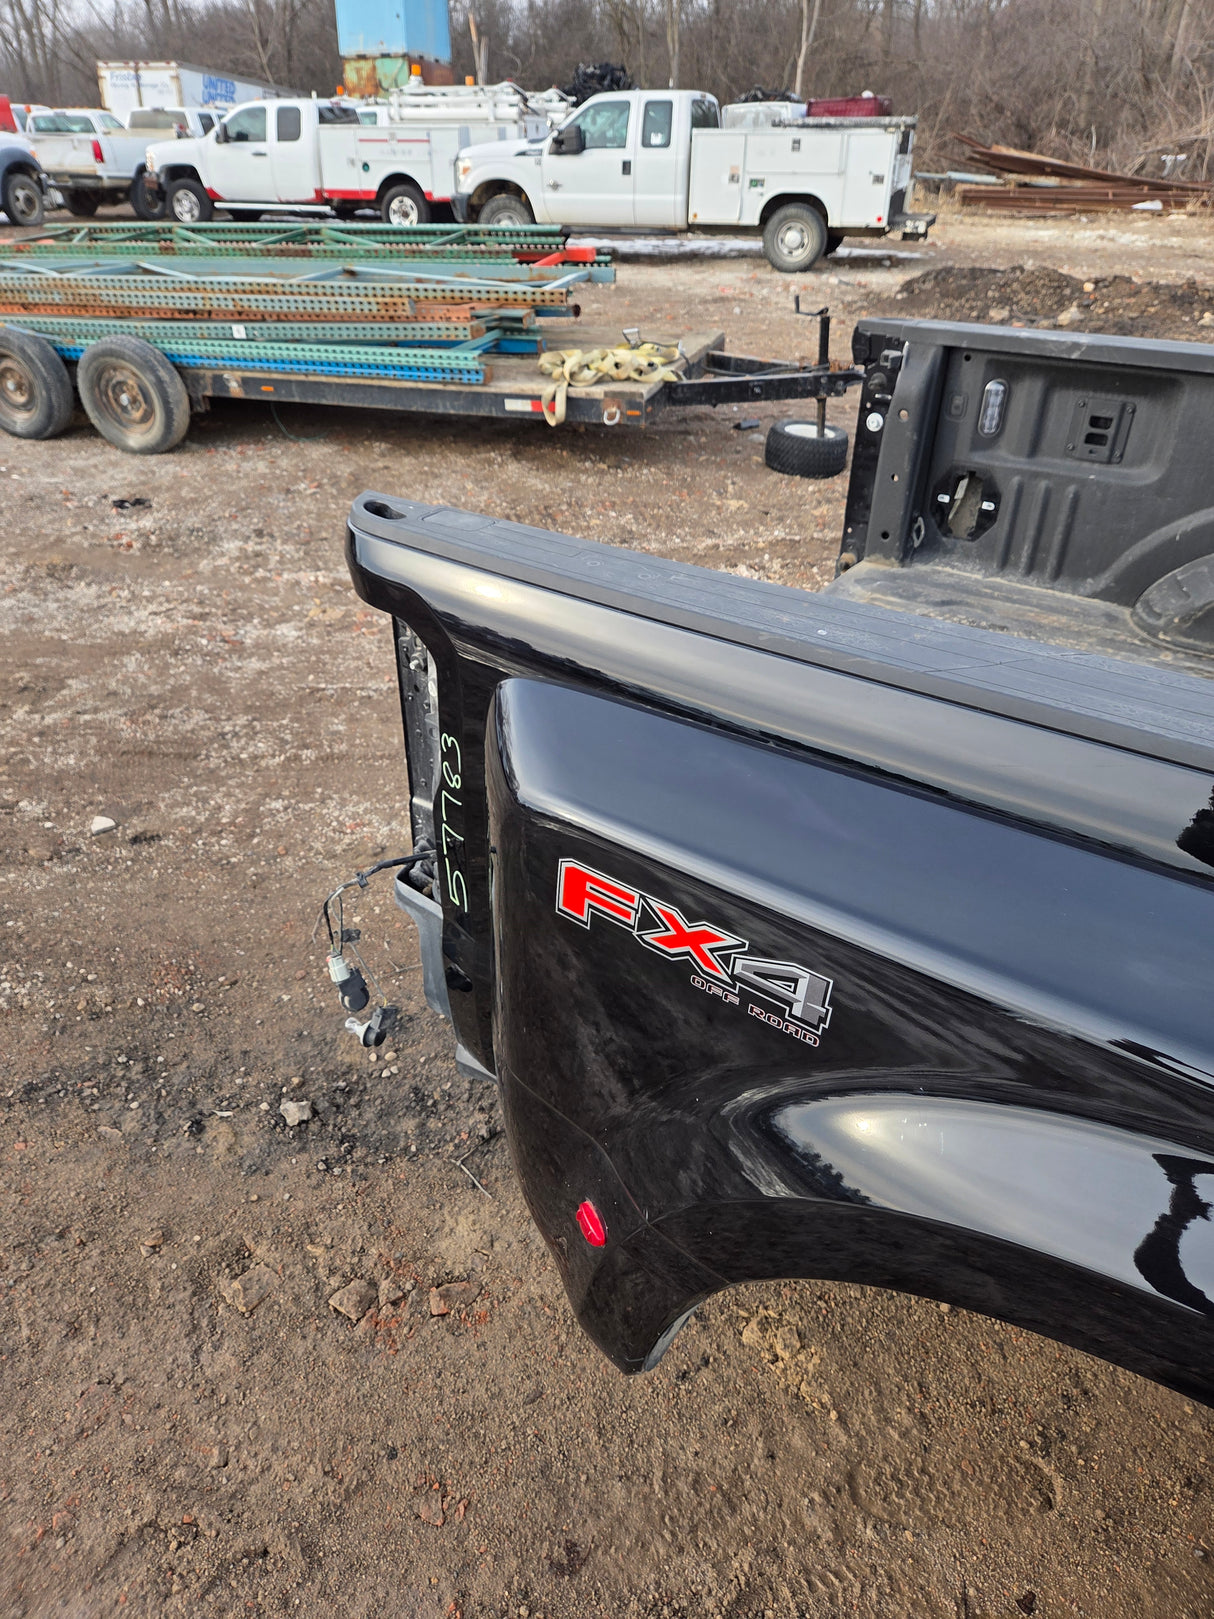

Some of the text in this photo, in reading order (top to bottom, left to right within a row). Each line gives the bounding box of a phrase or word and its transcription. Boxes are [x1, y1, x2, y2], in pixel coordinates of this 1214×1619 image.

[202, 73, 236, 95] UNITED
[441, 732, 468, 913] 57783
[555, 858, 834, 1035] FX4
[690, 974, 820, 1048] OFF ROAD
